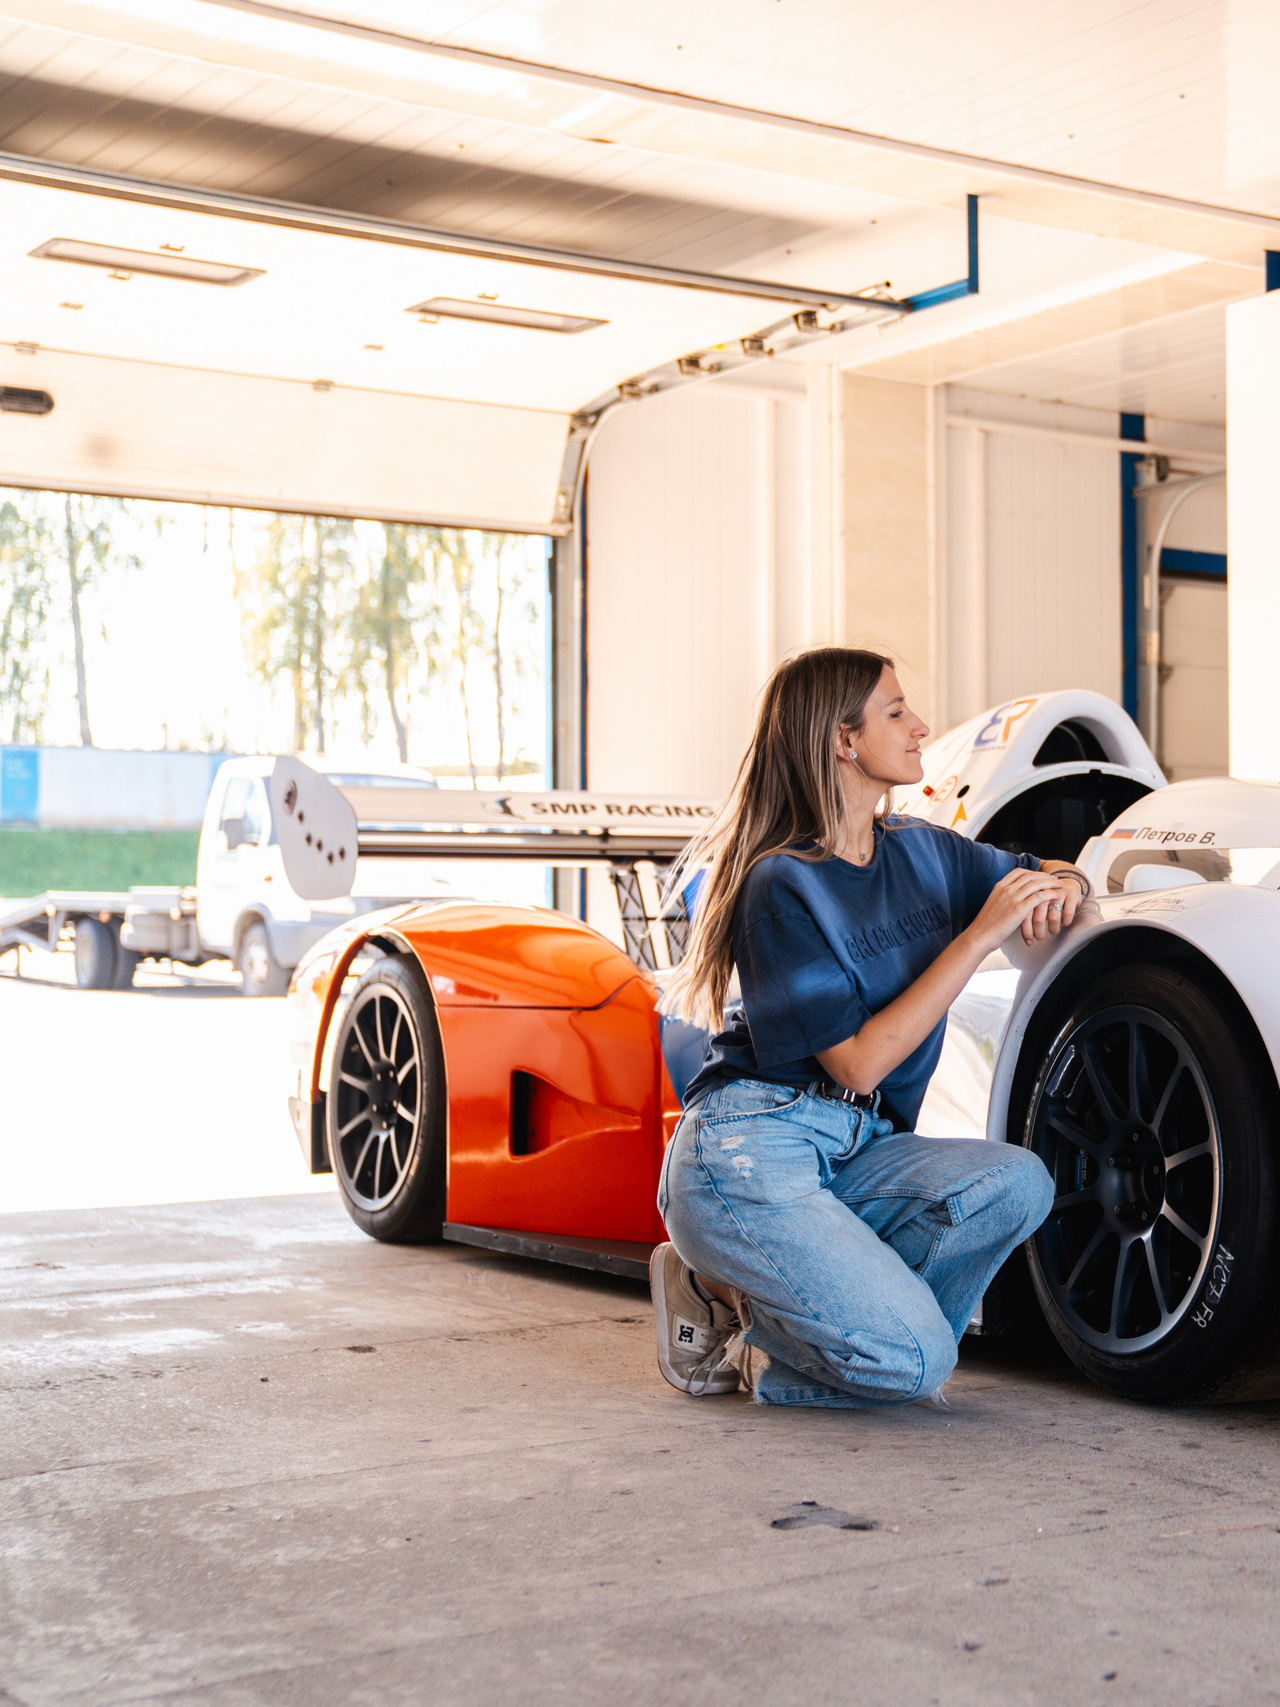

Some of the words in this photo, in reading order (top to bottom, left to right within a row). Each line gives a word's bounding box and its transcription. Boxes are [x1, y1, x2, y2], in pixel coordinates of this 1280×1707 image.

[531, 801, 597, 815] SMP
[604, 803, 714, 818] RACING
[1136, 827, 1197, 844] Петров
[1199, 831, 1216, 846] В.
